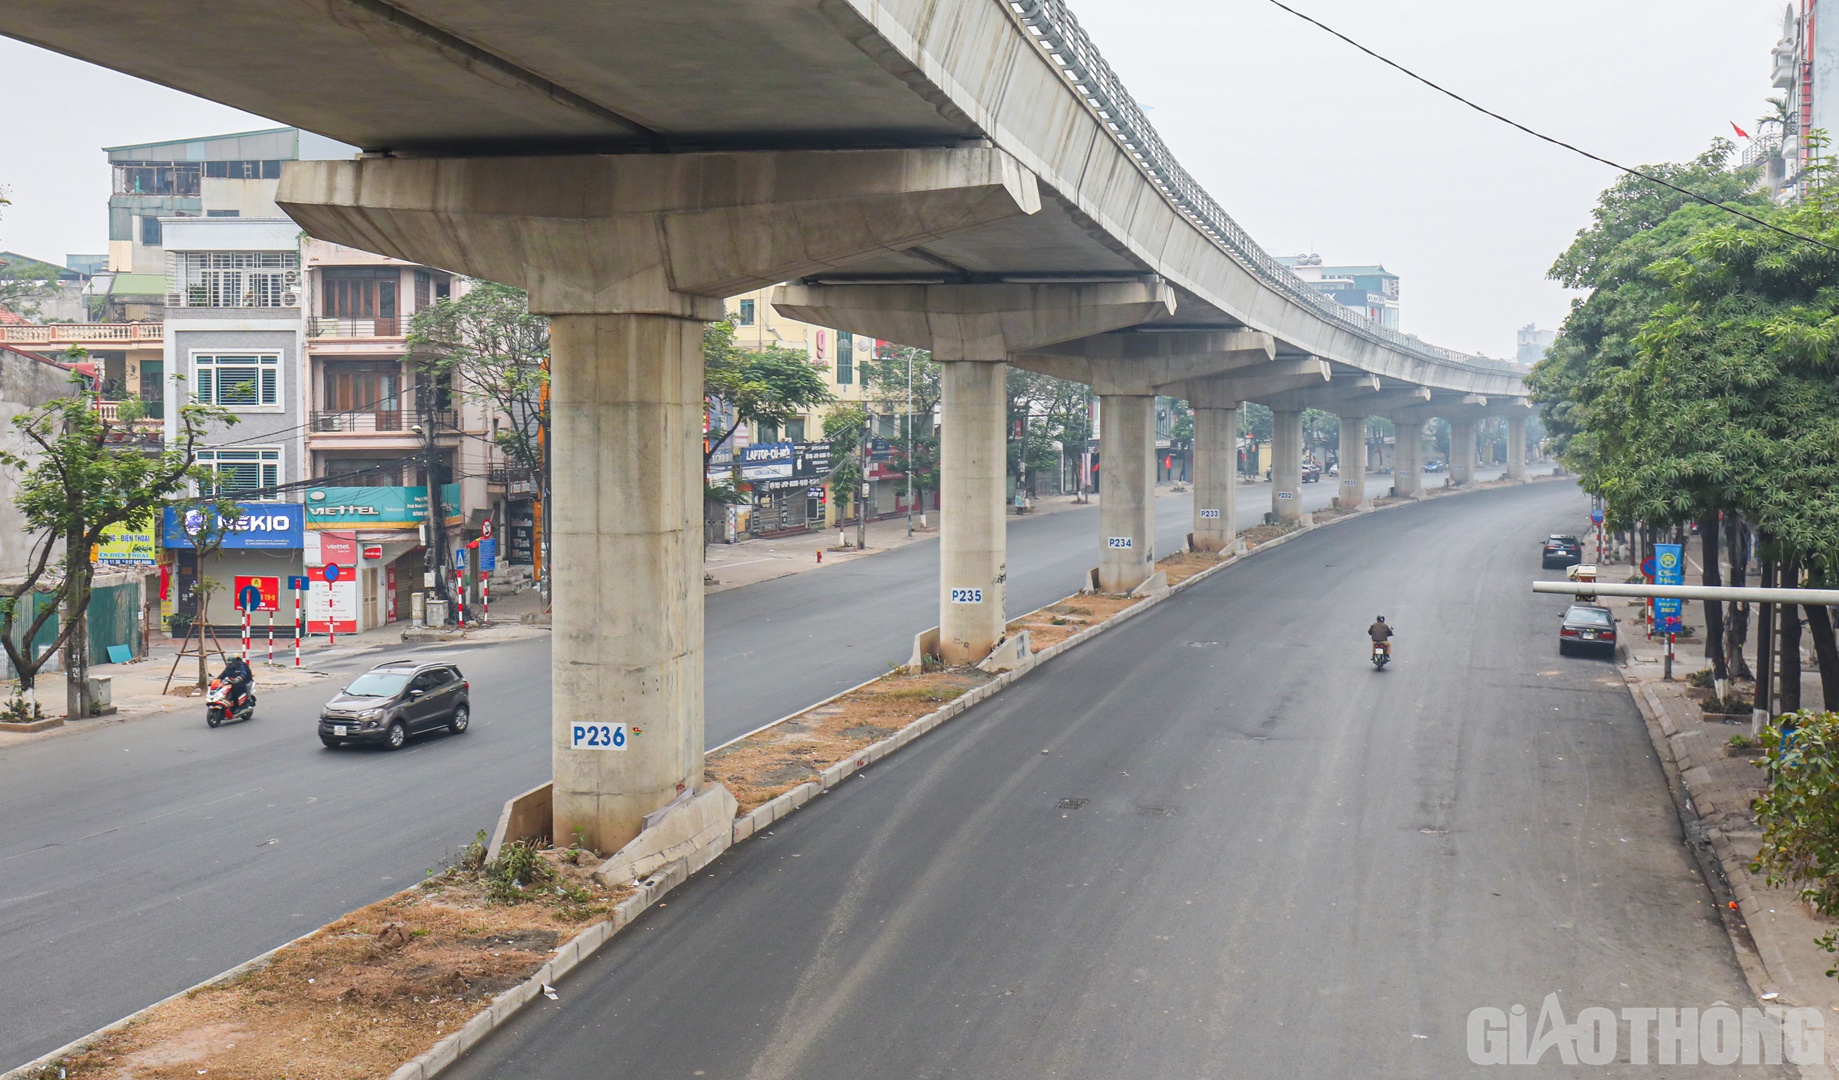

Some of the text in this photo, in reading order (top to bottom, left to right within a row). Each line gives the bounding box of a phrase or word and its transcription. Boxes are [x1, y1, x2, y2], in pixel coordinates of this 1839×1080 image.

[1109, 538, 1132, 547] P234
[952, 590, 982, 602] P235
[573, 725, 625, 747] P236
